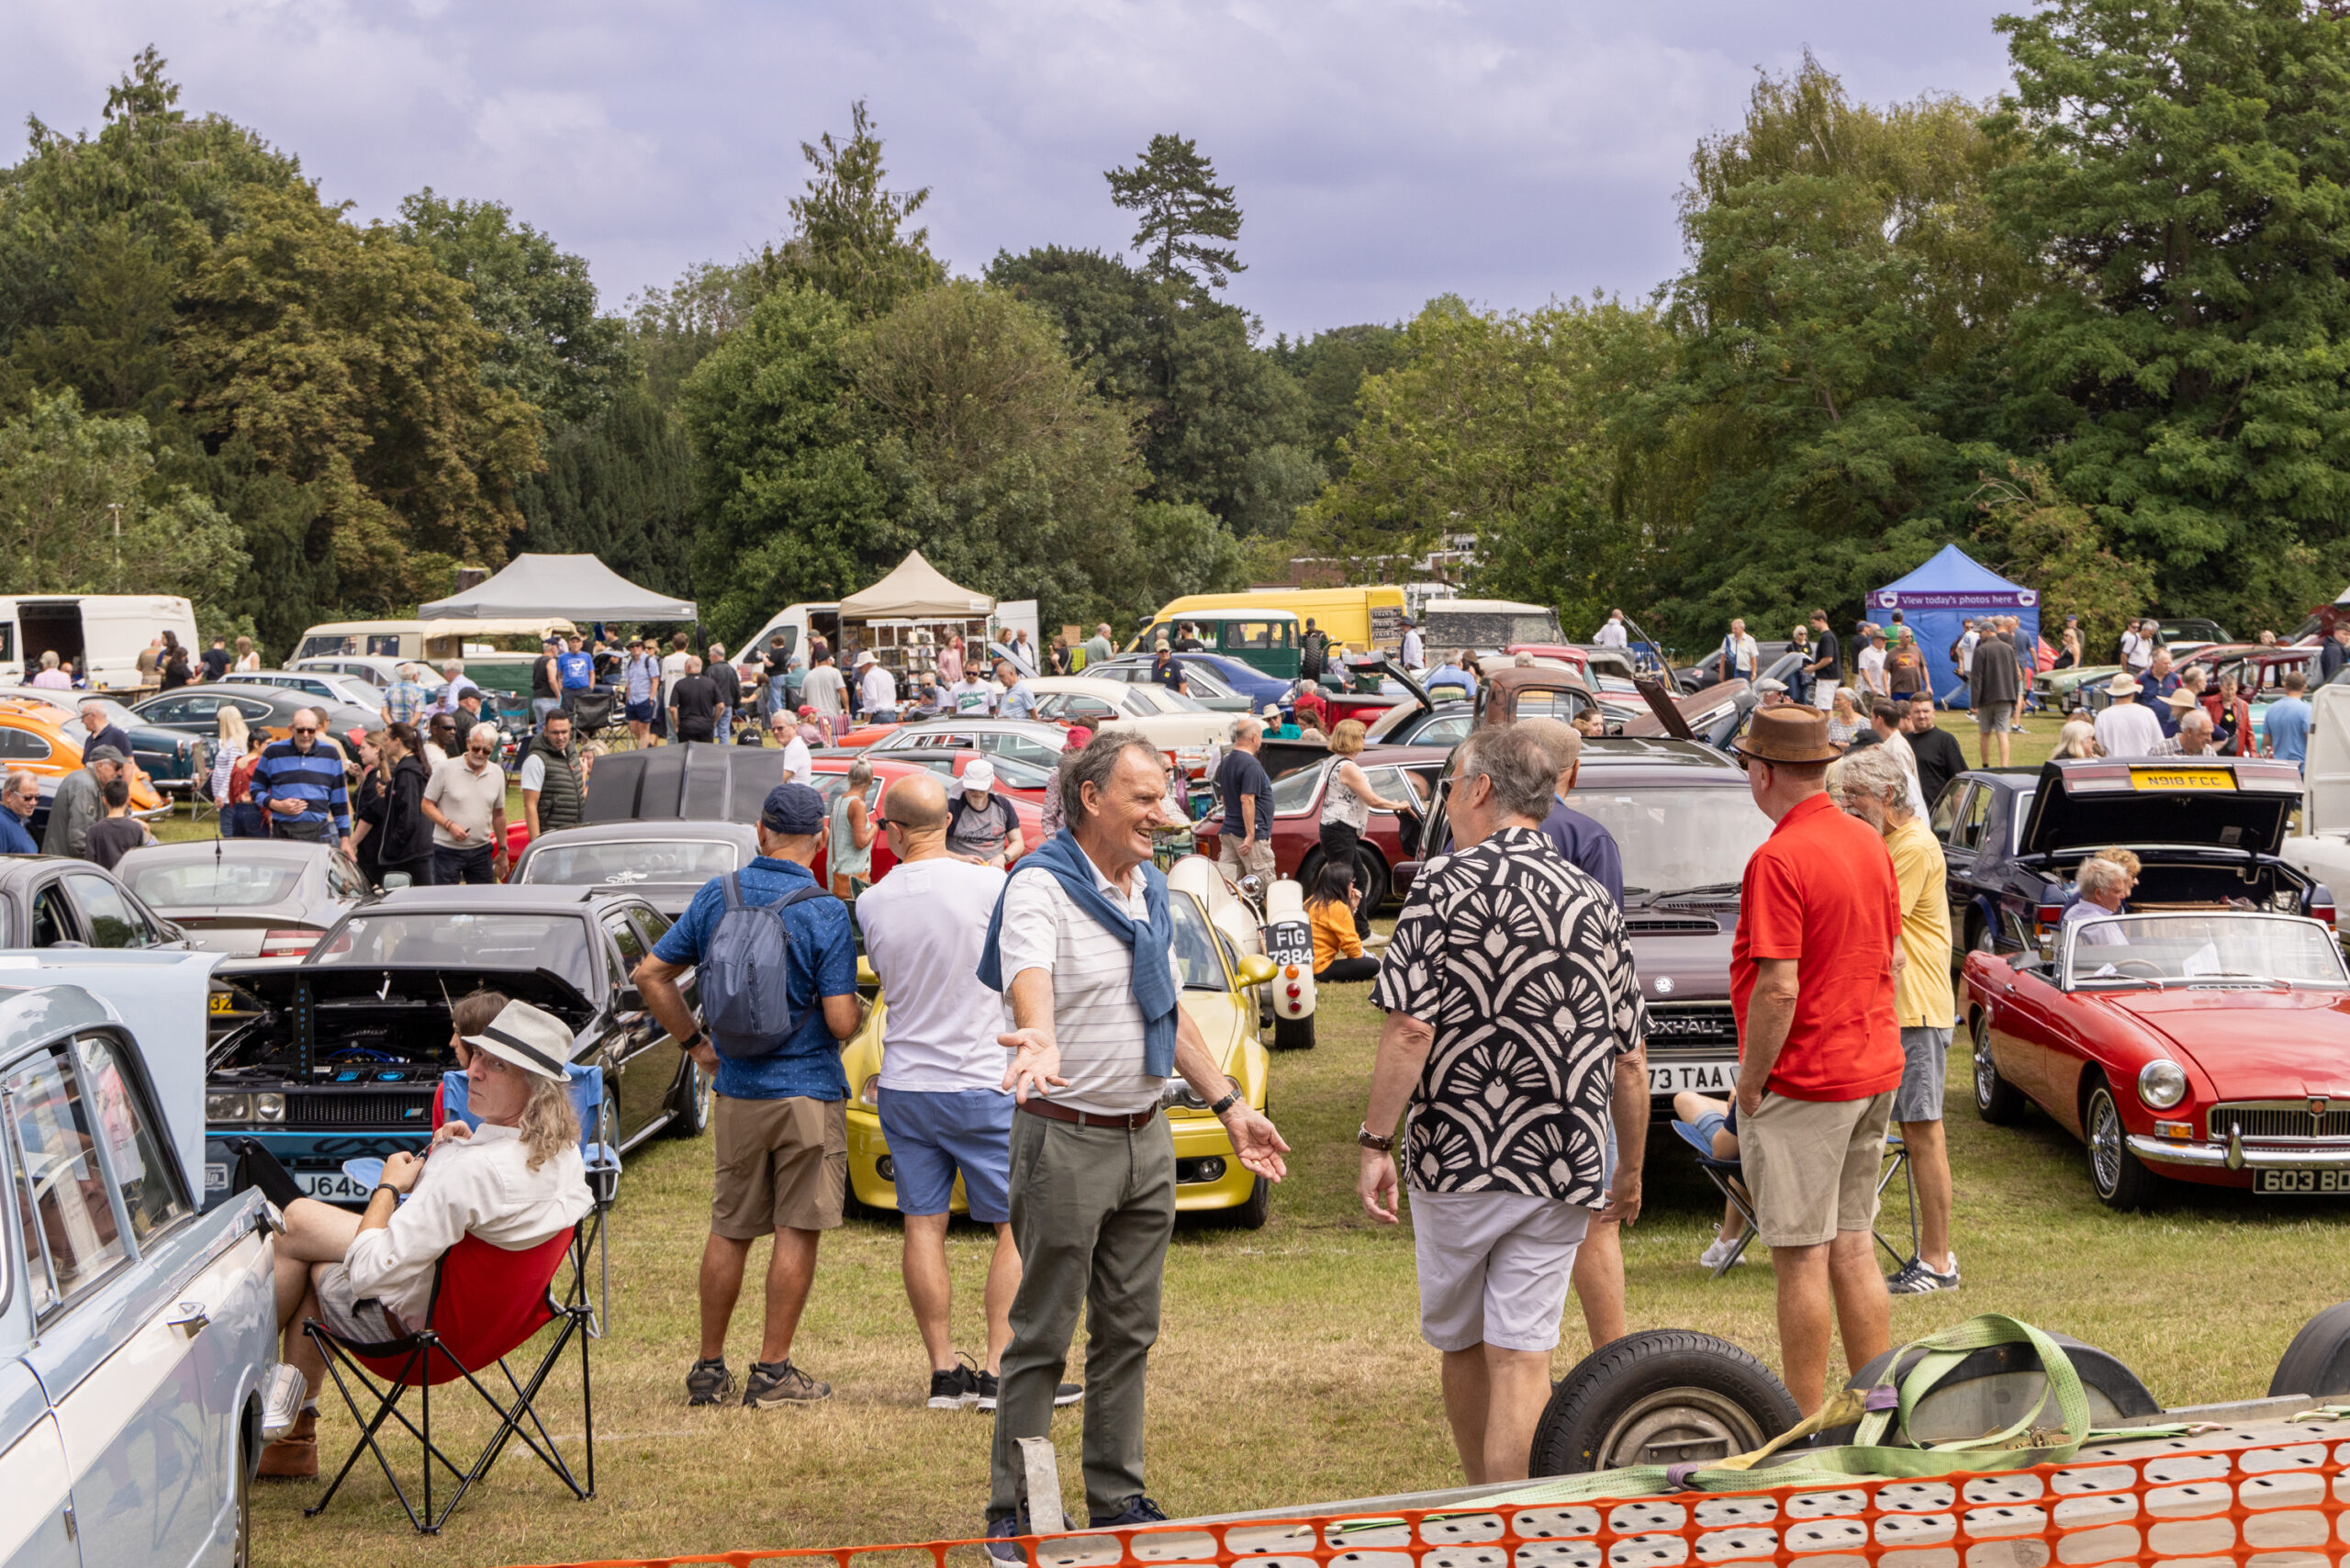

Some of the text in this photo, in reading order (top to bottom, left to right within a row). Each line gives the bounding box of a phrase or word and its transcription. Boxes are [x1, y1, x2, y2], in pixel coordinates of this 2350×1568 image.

[1901, 595, 2012, 606] View today's photos here
[2147, 776, 2221, 787] N918 FCC
[1276, 928, 1306, 947] FIG
[1268, 947, 1315, 966] 7384
[1650, 1020, 1724, 1035] UXHALL
[1648, 1066, 1724, 1090] 73 TAA
[306, 1176, 367, 1197] J648
[2264, 1170, 2314, 1191] 603
